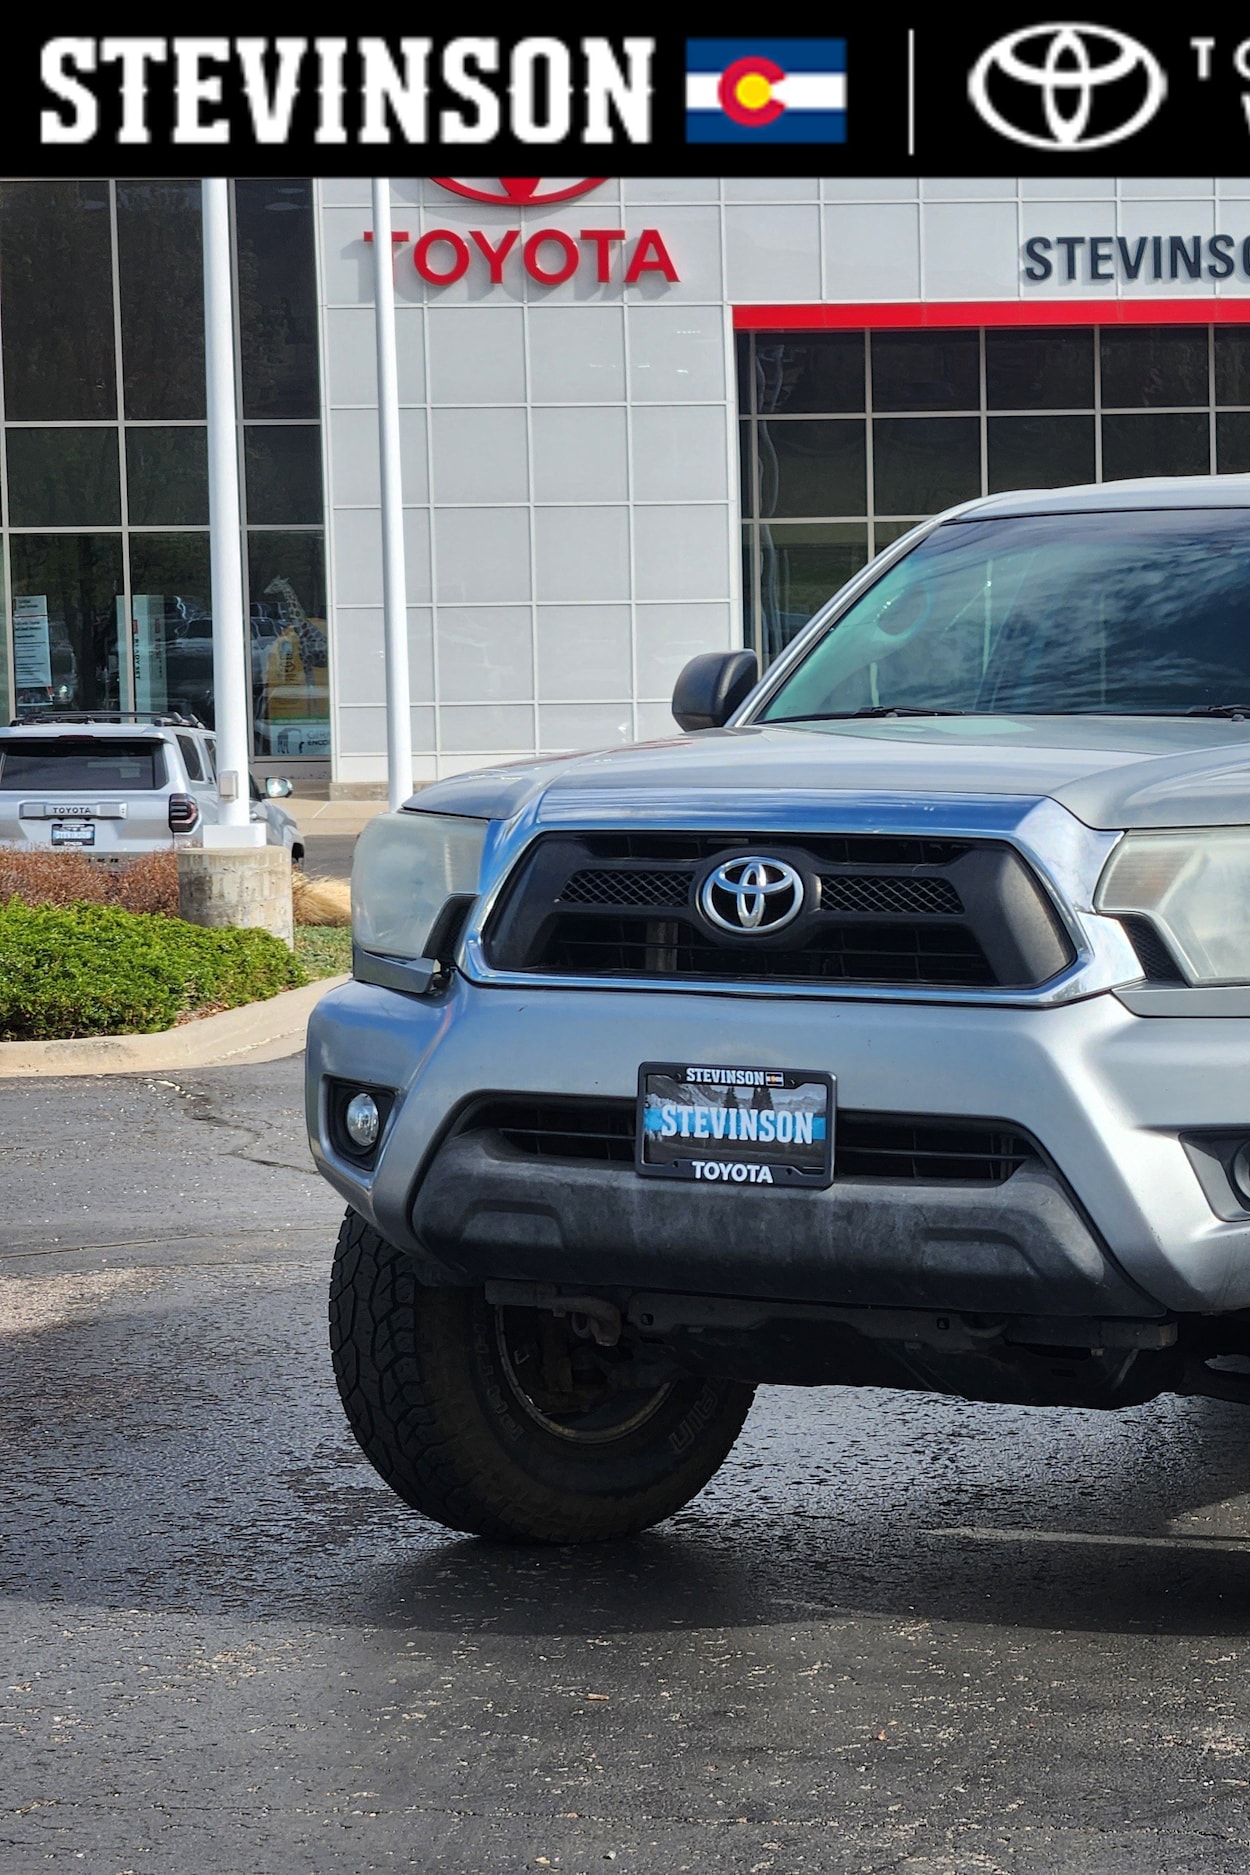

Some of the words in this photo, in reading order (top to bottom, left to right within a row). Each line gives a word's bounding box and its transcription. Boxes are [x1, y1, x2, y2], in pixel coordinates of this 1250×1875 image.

[686, 1068, 764, 1086] STEVINSON
[661, 1104, 814, 1144] STEVINSON
[692, 1161, 774, 1184] TOYOTA
